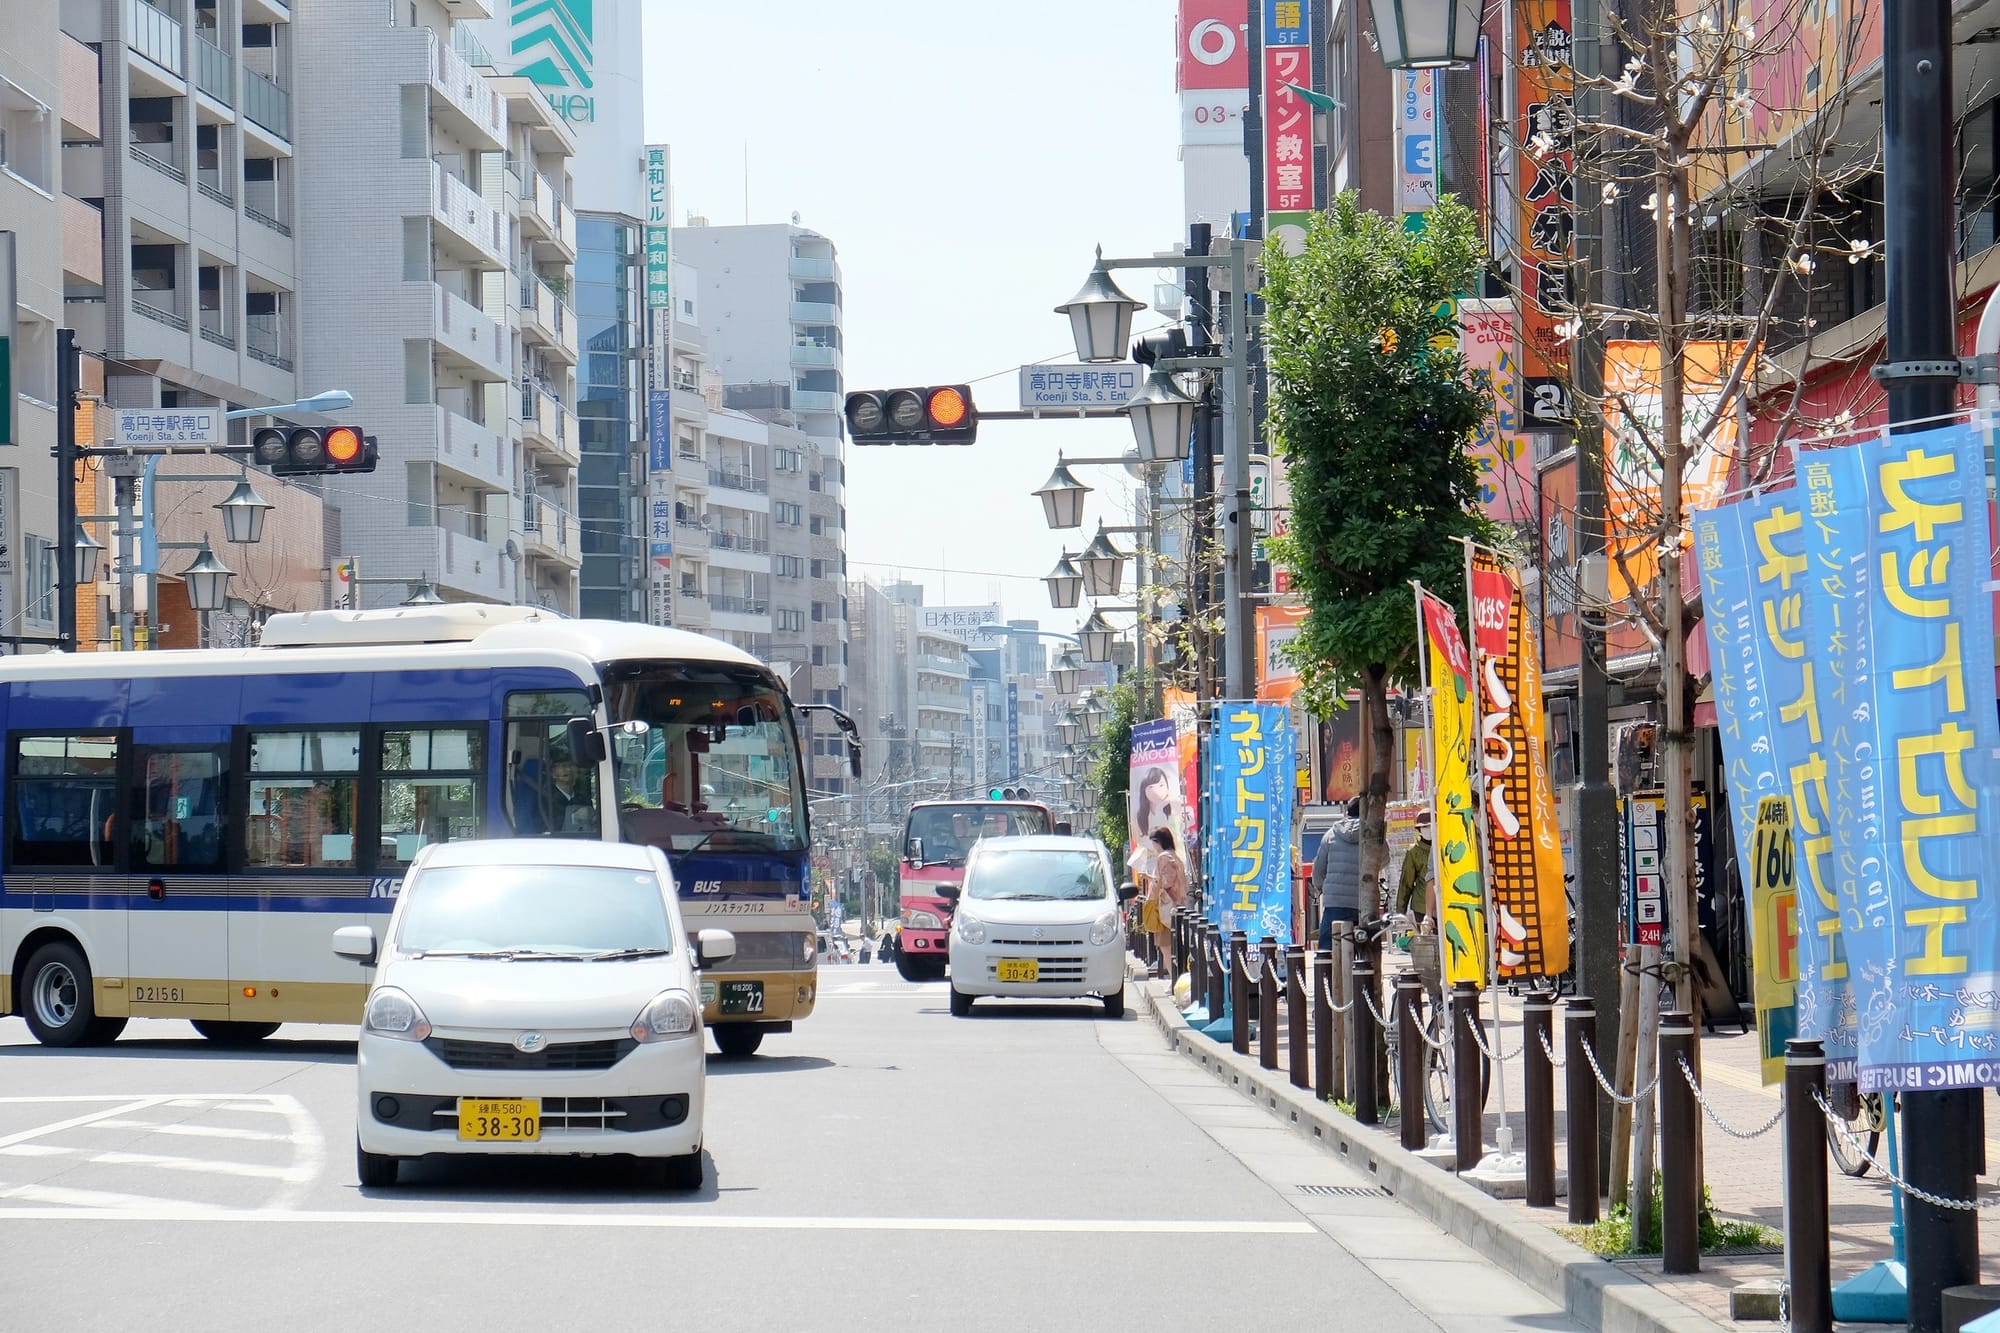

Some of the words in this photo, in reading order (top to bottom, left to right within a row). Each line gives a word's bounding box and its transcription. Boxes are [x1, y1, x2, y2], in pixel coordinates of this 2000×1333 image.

[1275, 1, 1302, 29] 語
[1278, 31, 1299, 44] 5F
[1275, 52, 1304, 191] ワイン教室
[648, 149, 665, 222] 真和ビル
[1279, 194, 1301, 208] 5F
[649, 230, 667, 305] 真和建設
[1030, 372, 1134, 390] 高円寺駅南口
[1035, 391, 1068, 403] Koenji
[1072, 391, 1092, 401] Sta.
[1096, 391, 1106, 401] S.
[1111, 391, 1130, 401] Ent.
[121, 415, 210, 431] 高円寺駅南口
[126, 432, 154, 442] Koenji
[158, 432, 175, 441] Sta.
[178, 432, 187, 441] S.
[191, 431, 207, 441] Ent.
[653, 501, 669, 538] 歯科
[925, 611, 997, 627] 日本医歯薬
[1230, 710, 1266, 911] ネットカフェ
[693, 880, 721, 893] BUS
[705, 903, 766, 914] ノンステップバス
[1642, 929, 1660, 942] 24H
[1006, 968, 1036, 980] 30-43
[136, 986, 184, 1001] D21561
[742, 983, 753, 992] 200
[478, 1104, 501, 1114] 練馬
[502, 1104, 523, 1115] 580
[477, 1117, 535, 1137] 38-30
